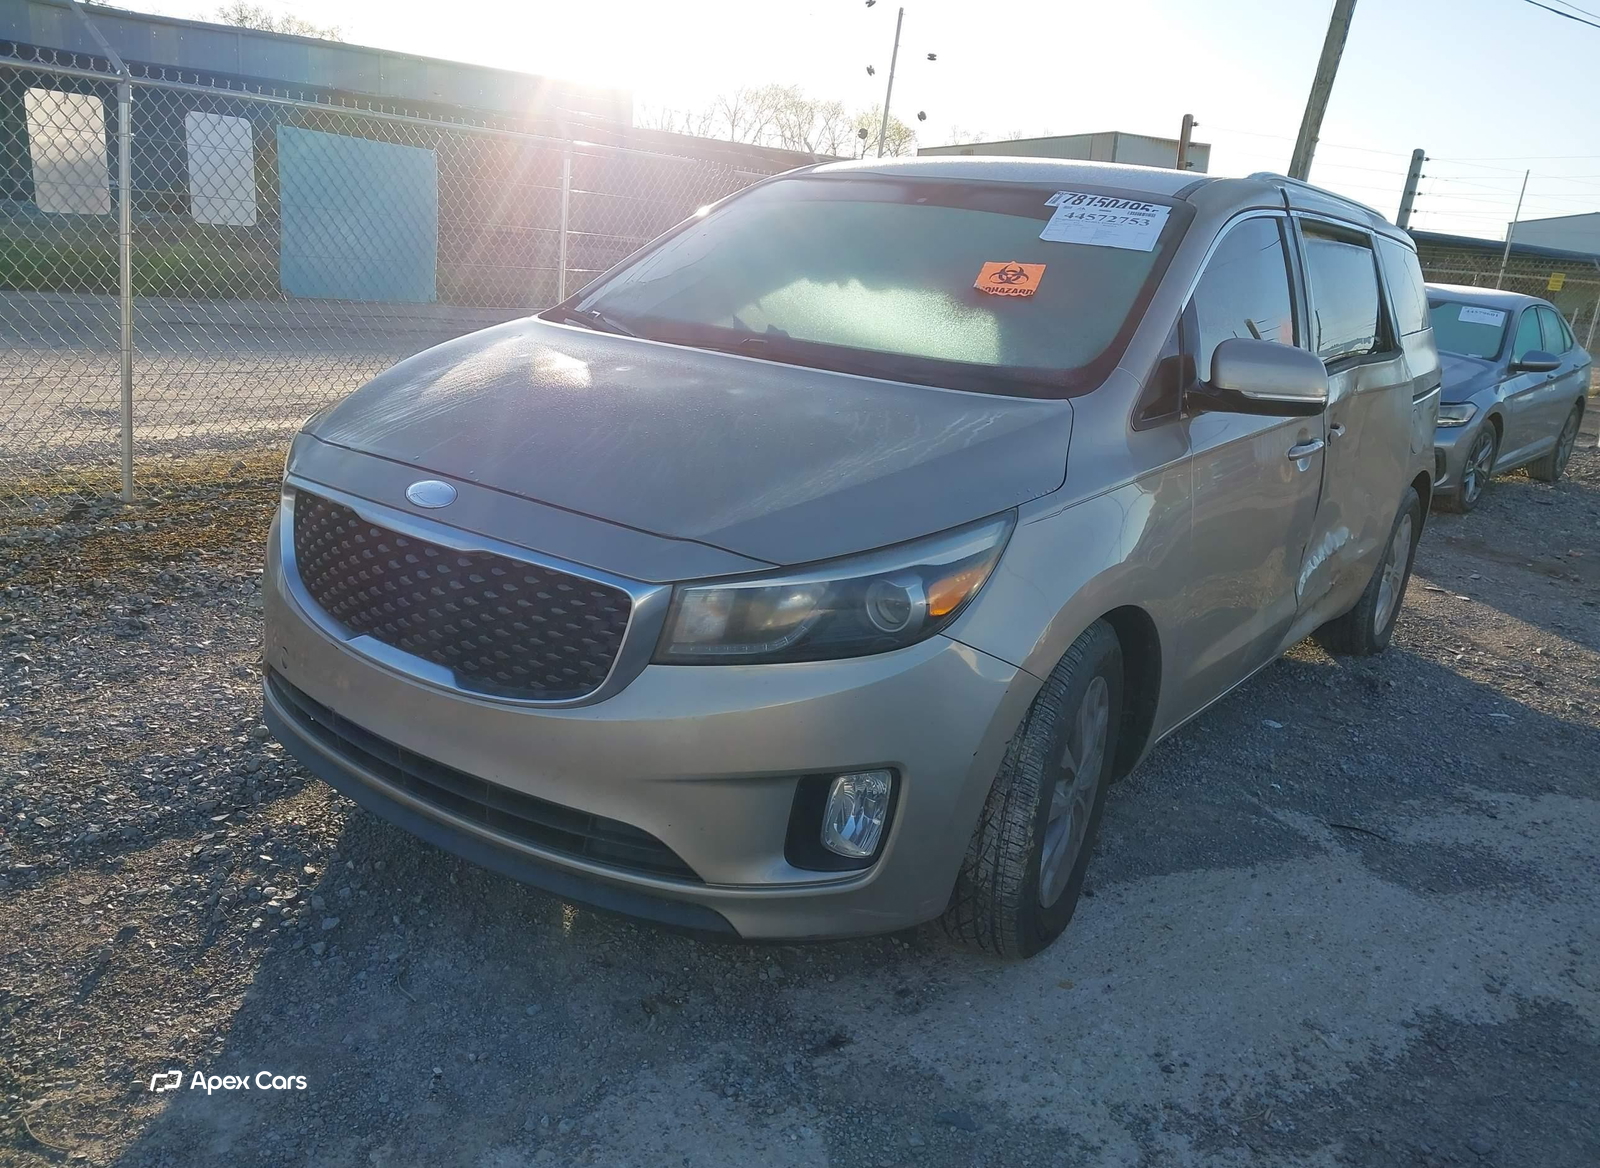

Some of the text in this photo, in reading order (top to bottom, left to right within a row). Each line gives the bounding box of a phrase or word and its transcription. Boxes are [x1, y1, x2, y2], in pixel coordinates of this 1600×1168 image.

[1062, 193, 1160, 213] 78150495
[1064, 211, 1150, 227] 44572753
[983, 286, 1034, 295] OHAZARD
